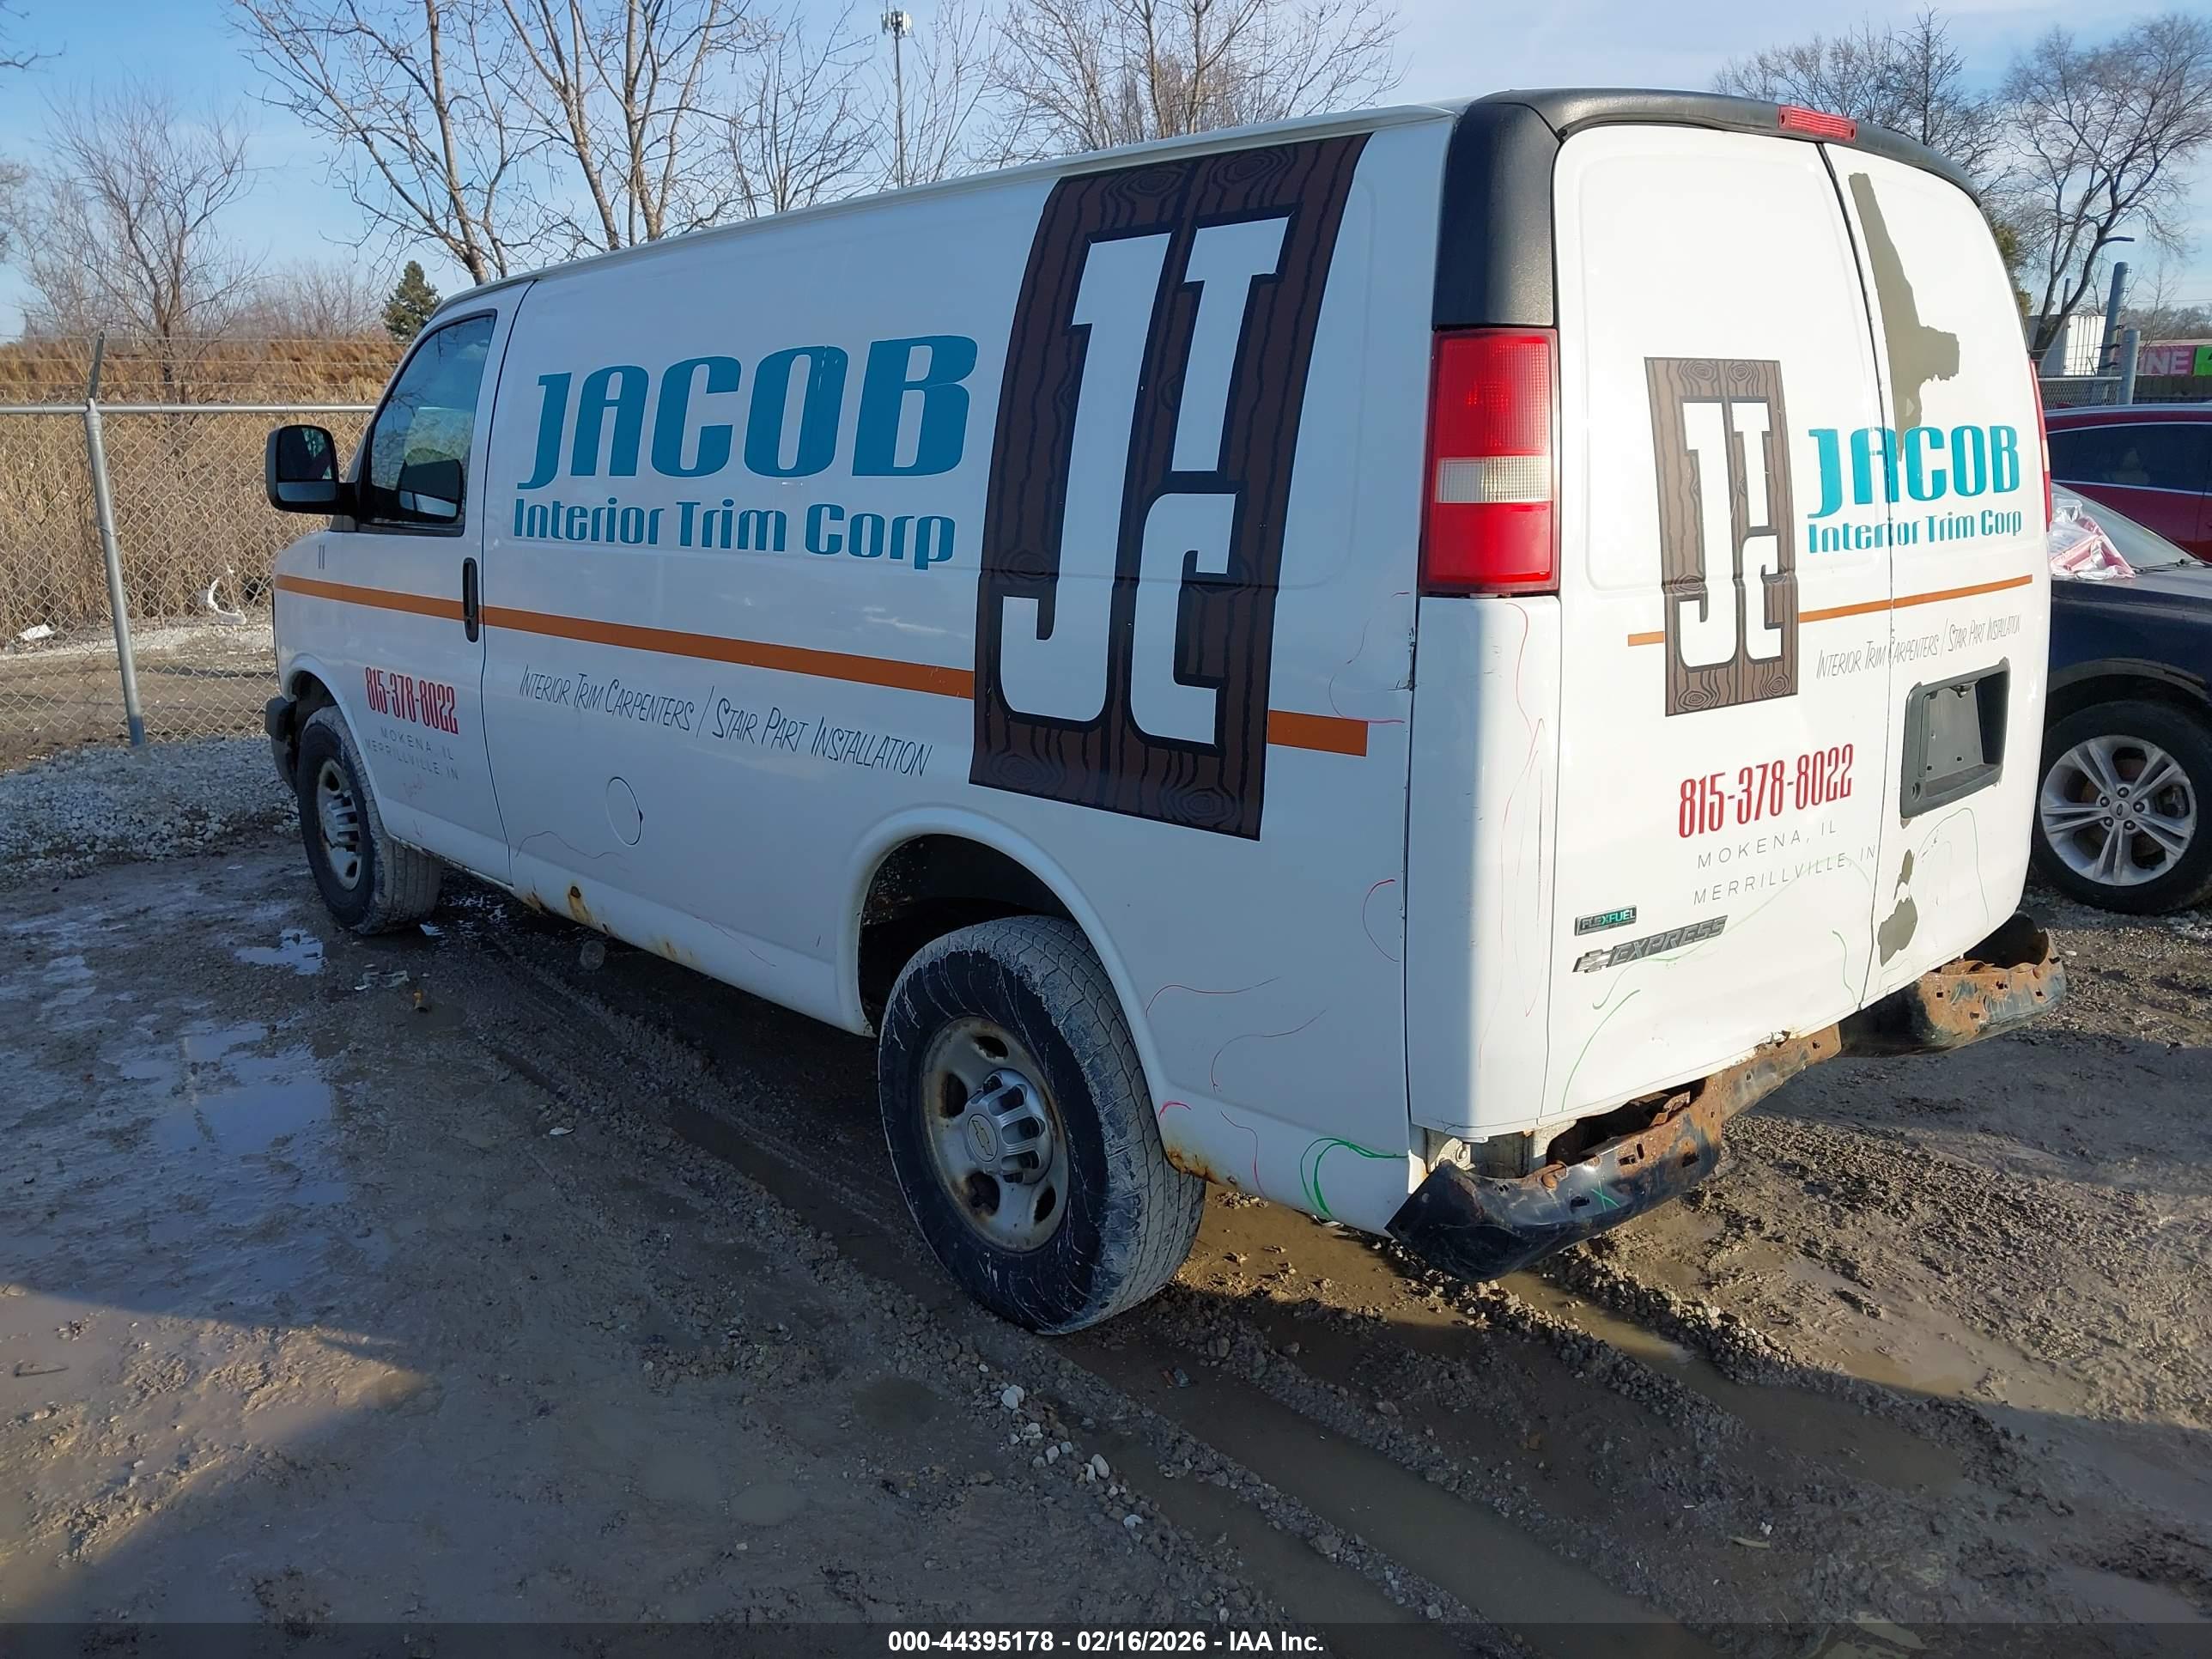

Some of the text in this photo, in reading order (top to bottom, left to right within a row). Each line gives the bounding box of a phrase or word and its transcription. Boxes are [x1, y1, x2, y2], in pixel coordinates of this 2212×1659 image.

[517, 335, 979, 489] JACOB
[1808, 424, 2021, 518] JACOB
[514, 496, 957, 570] Interior Trim Corp
[1808, 508, 2022, 554] Interior Trim Corp
[365, 665, 459, 735] 815-378-8022
[1678, 743, 1854, 839] 815-378-8022
[1697, 818, 1838, 870] MOKENA, IL
[1860, 844, 1877, 862] IN
[1610, 918, 1727, 966] EXPRESS
